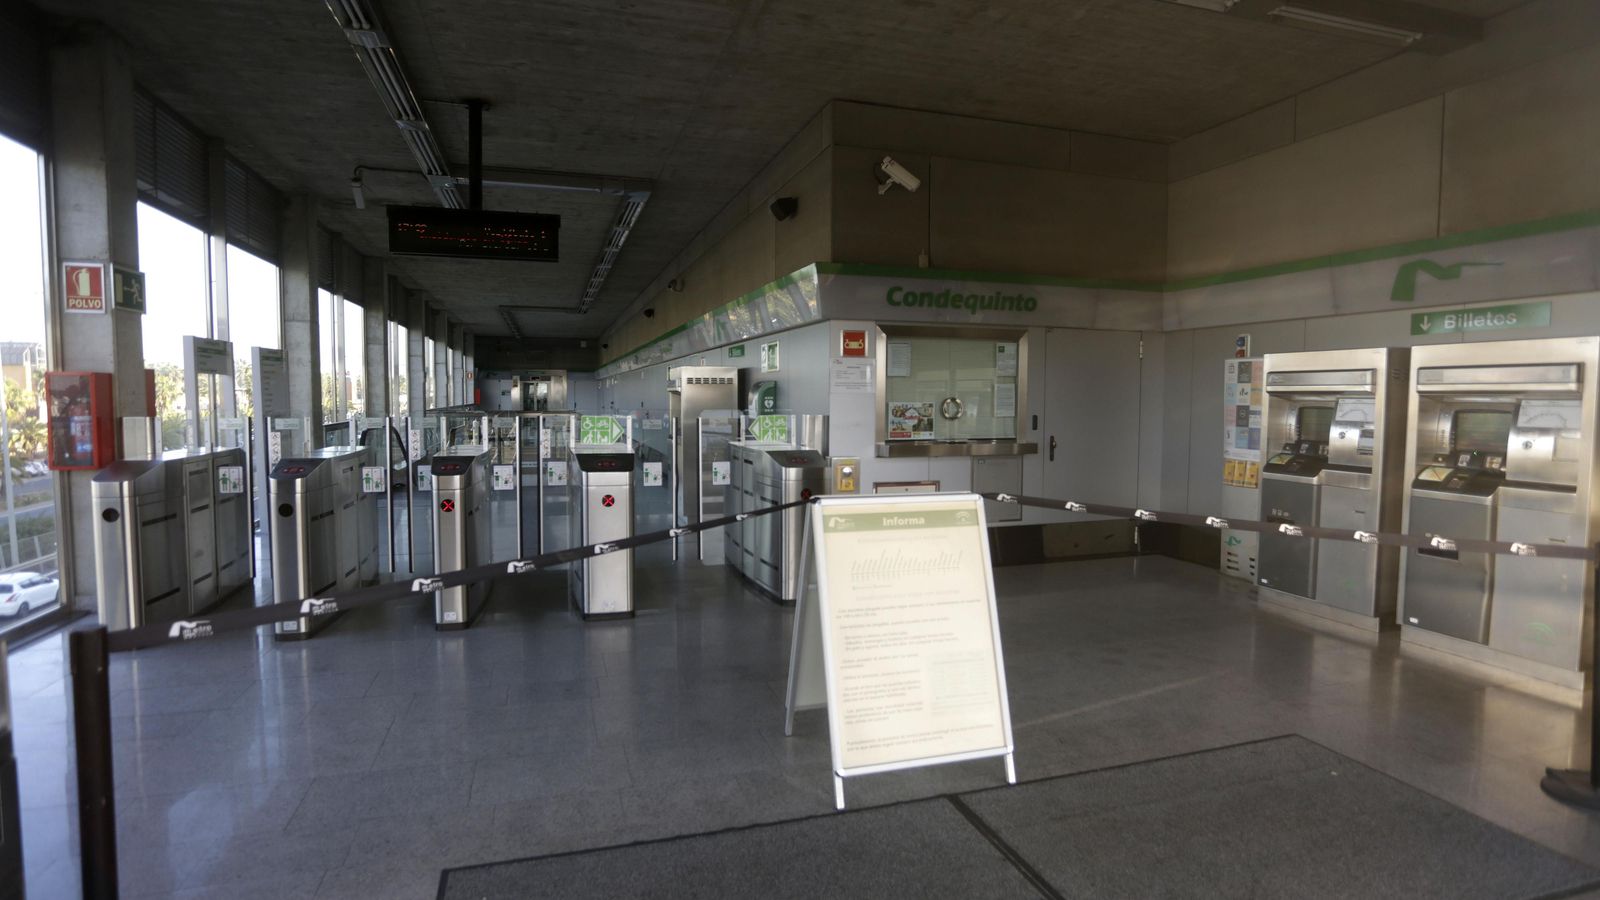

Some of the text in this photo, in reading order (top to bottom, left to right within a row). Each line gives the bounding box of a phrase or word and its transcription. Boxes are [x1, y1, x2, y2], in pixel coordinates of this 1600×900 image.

[69, 298, 101, 308] POLVO
[887, 286, 1037, 315] Condequinto
[882, 516, 925, 526] Informa
